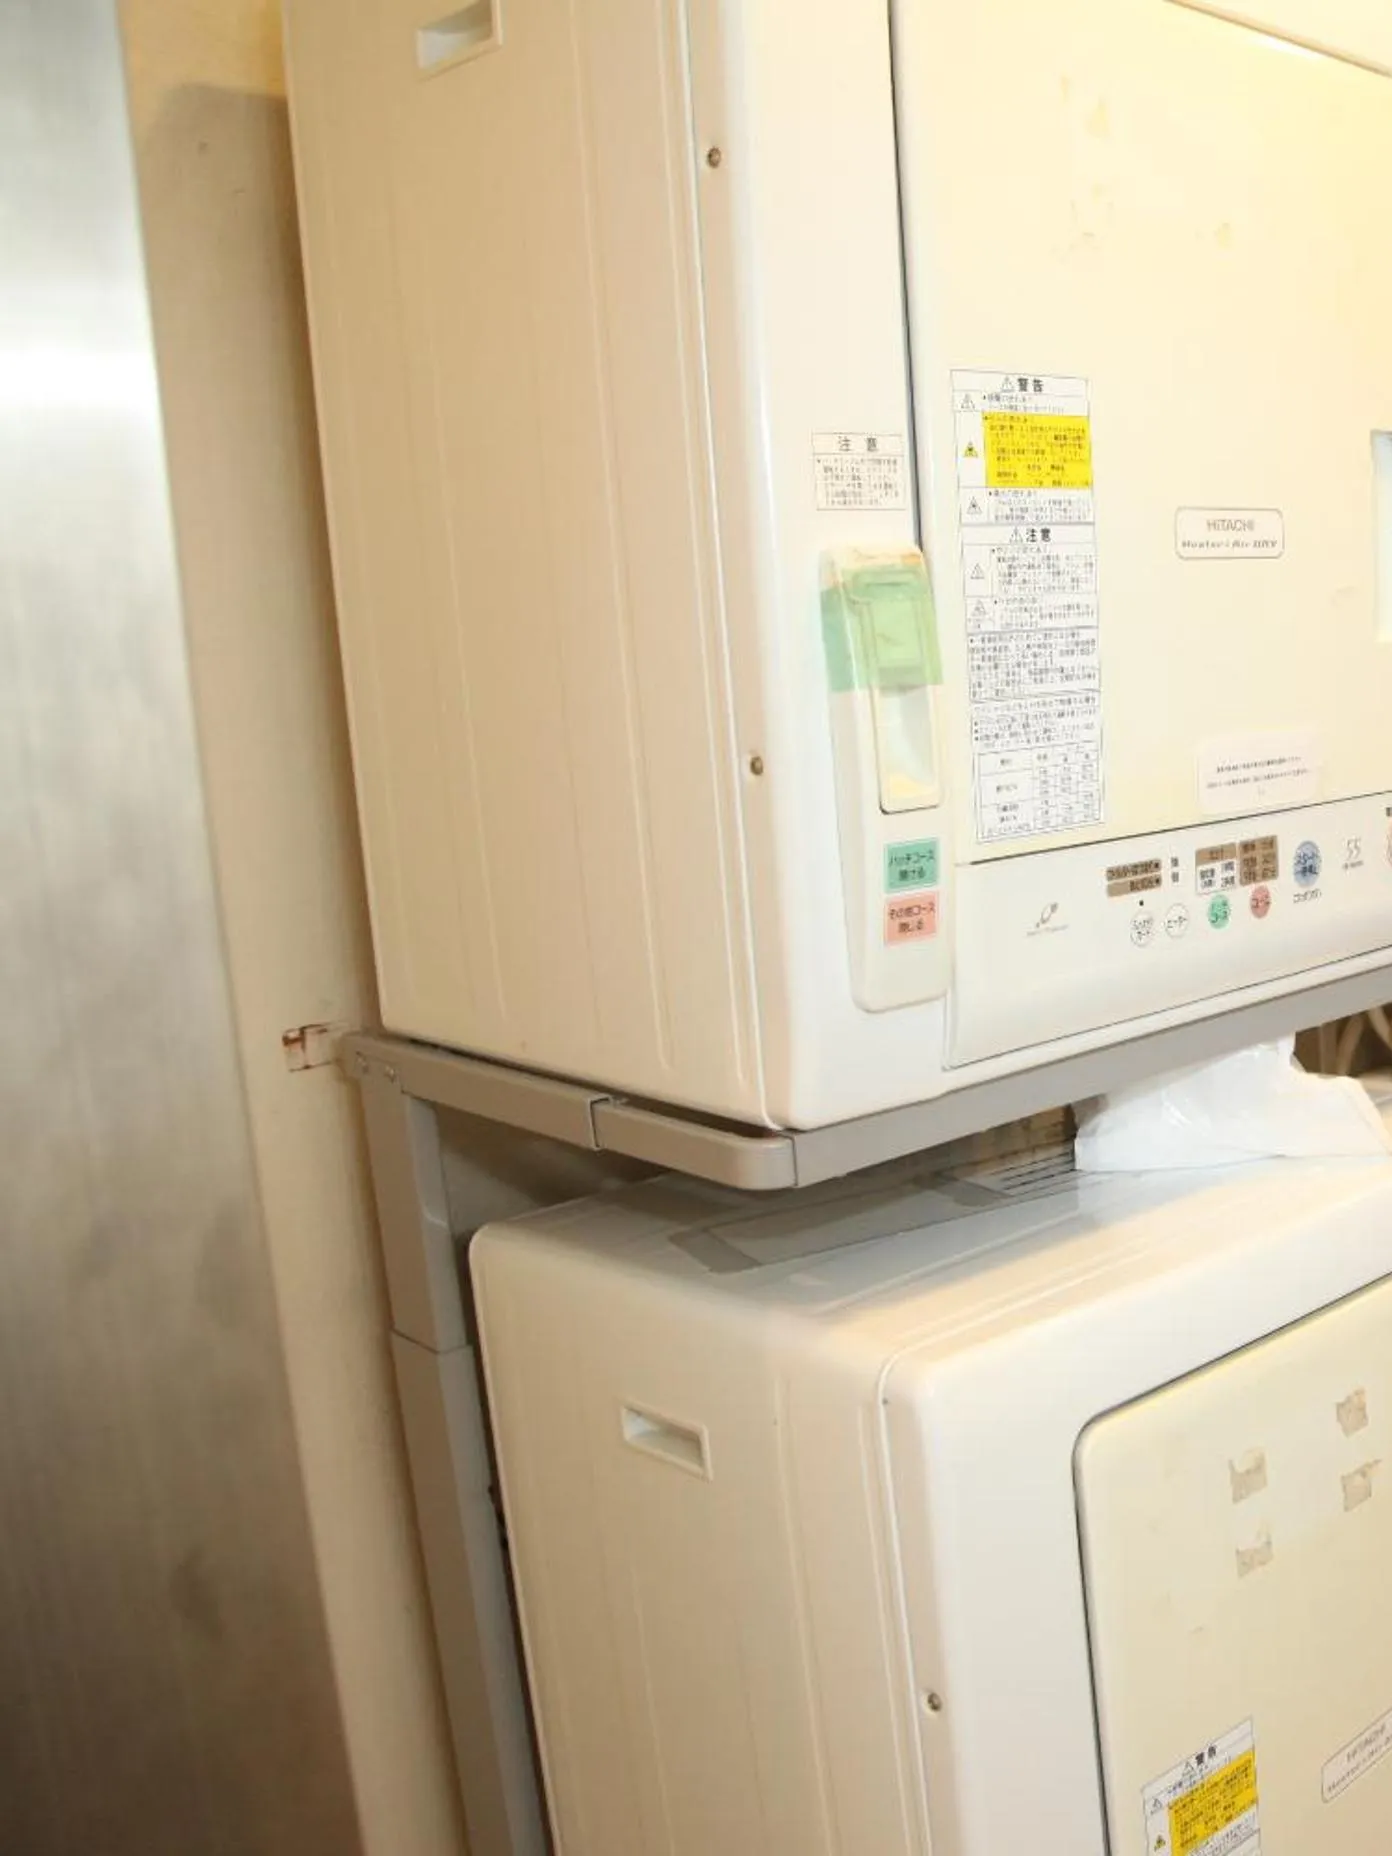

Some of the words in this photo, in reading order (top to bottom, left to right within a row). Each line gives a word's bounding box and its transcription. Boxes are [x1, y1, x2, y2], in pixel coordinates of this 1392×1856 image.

[838, 435, 879, 453] 注意
[1206, 518, 1255, 532] HITACHI
[1025, 527, 1051, 543] 注意
